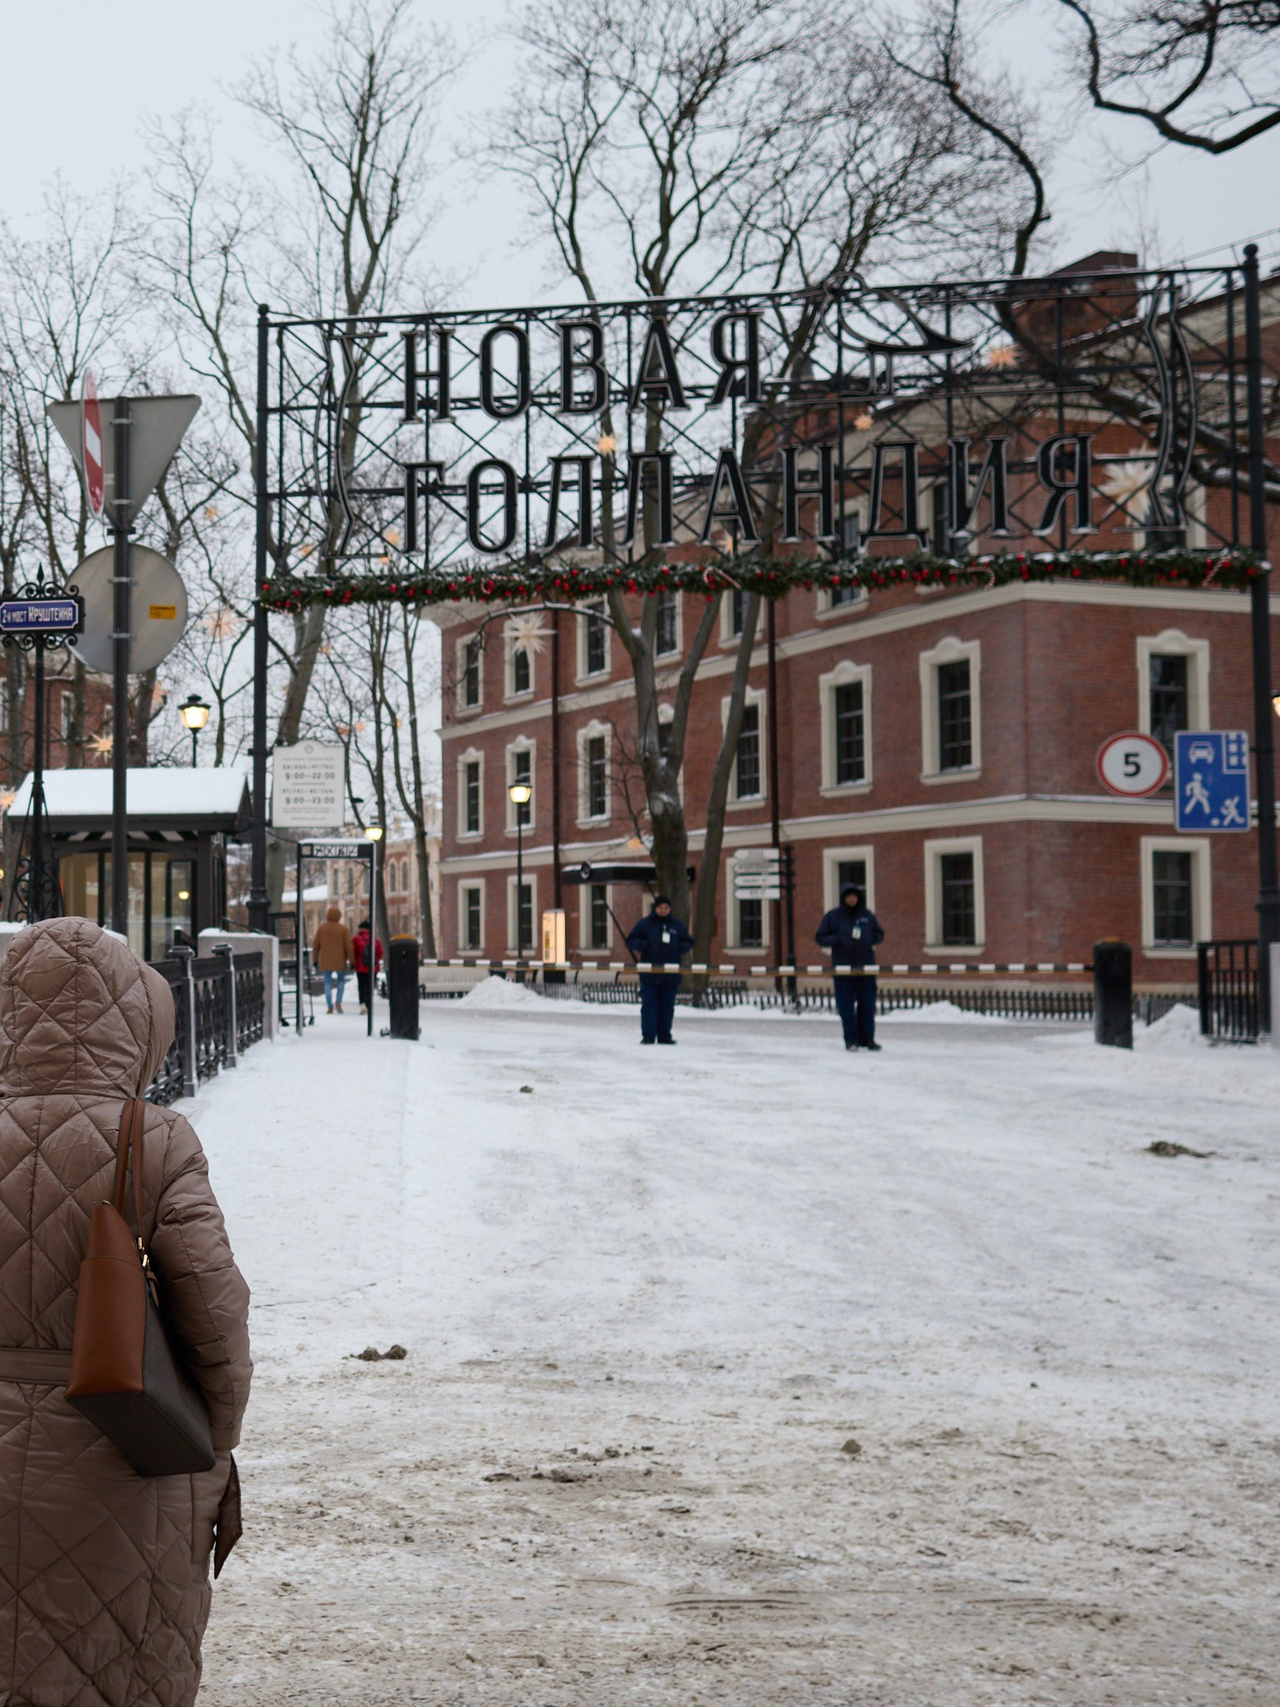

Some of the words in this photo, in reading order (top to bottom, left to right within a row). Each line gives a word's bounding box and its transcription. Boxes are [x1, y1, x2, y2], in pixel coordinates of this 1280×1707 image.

[399, 310, 767, 425] НОВАЯ
[401, 432, 1096, 555] ГОЛЛАНДИЯ
[1123, 753, 1141, 778] 5
